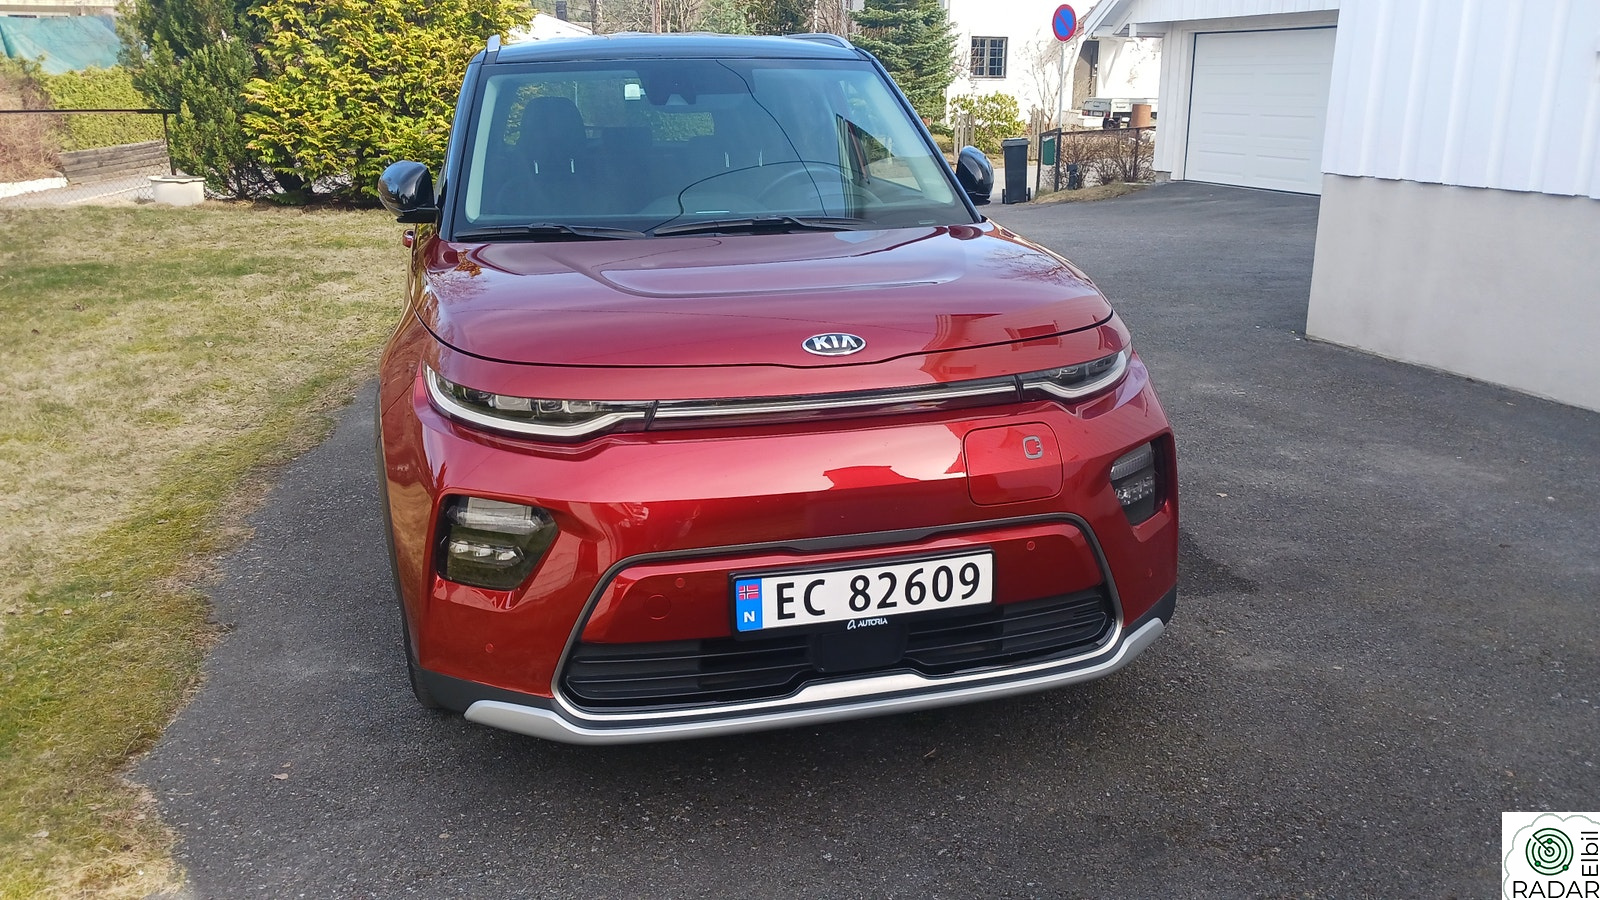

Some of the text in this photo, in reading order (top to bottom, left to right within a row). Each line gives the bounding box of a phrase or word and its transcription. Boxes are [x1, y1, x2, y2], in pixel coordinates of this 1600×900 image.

[812, 335, 858, 350] KIA
[776, 562, 981, 621] EC 82609
[743, 610, 756, 623] N
[857, 617, 888, 628] AUTORIA
